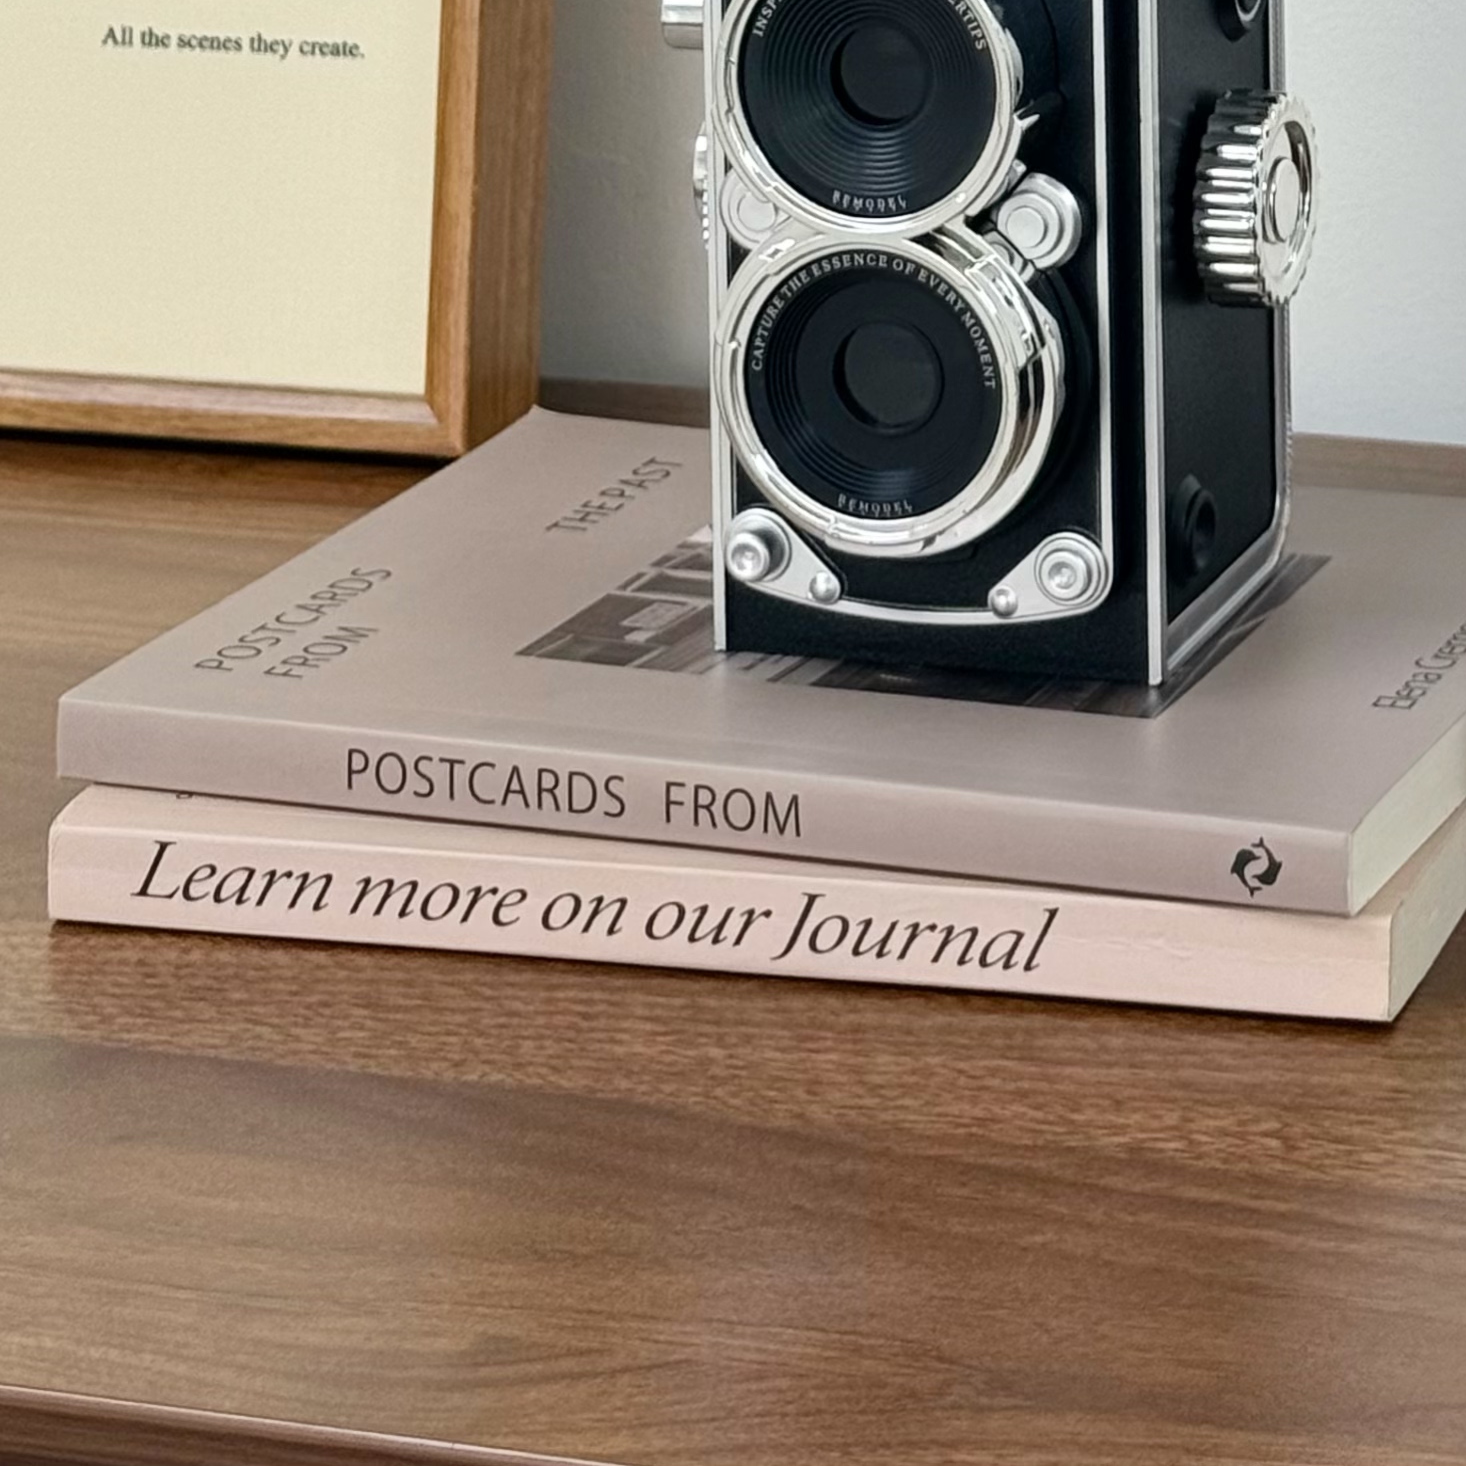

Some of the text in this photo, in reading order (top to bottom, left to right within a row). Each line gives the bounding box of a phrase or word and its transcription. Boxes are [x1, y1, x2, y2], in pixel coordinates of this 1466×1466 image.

[102, 24, 366, 60] All the scenes they create.
[751, 252, 997, 390] CAPTURE THE ESSENCE OF EVERY MOMENT
[545, 456, 683, 532] THE PAST
[193, 567, 392, 672] POSTCARDS
[263, 625, 380, 679] FROM
[1371, 671, 1442, 710] Elena
[346, 747, 802, 838] POSTCARDS FROM
[131, 839, 1059, 974] Learn more on our Journal
